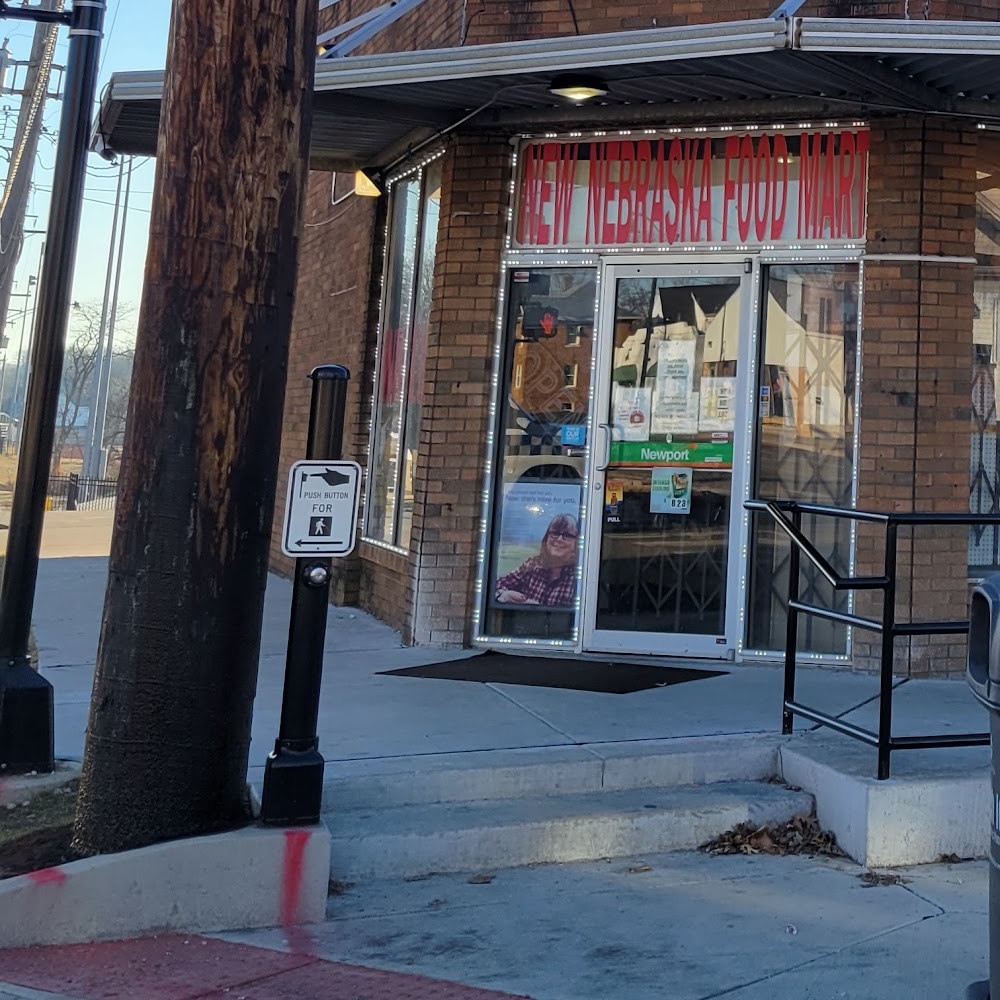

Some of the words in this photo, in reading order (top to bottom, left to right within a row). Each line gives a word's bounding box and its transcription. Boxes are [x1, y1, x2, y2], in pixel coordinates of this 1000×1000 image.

[522, 142, 578, 245] NEW
[585, 136, 712, 245] NEBRASKA
[722, 133, 789, 243] FOOD
[797, 130, 871, 241] MART
[640, 448, 690, 462] Newport
[303, 491, 322, 499] PUSH
[324, 491, 349, 499] BUTTON
[312, 504, 333, 513] FOR
